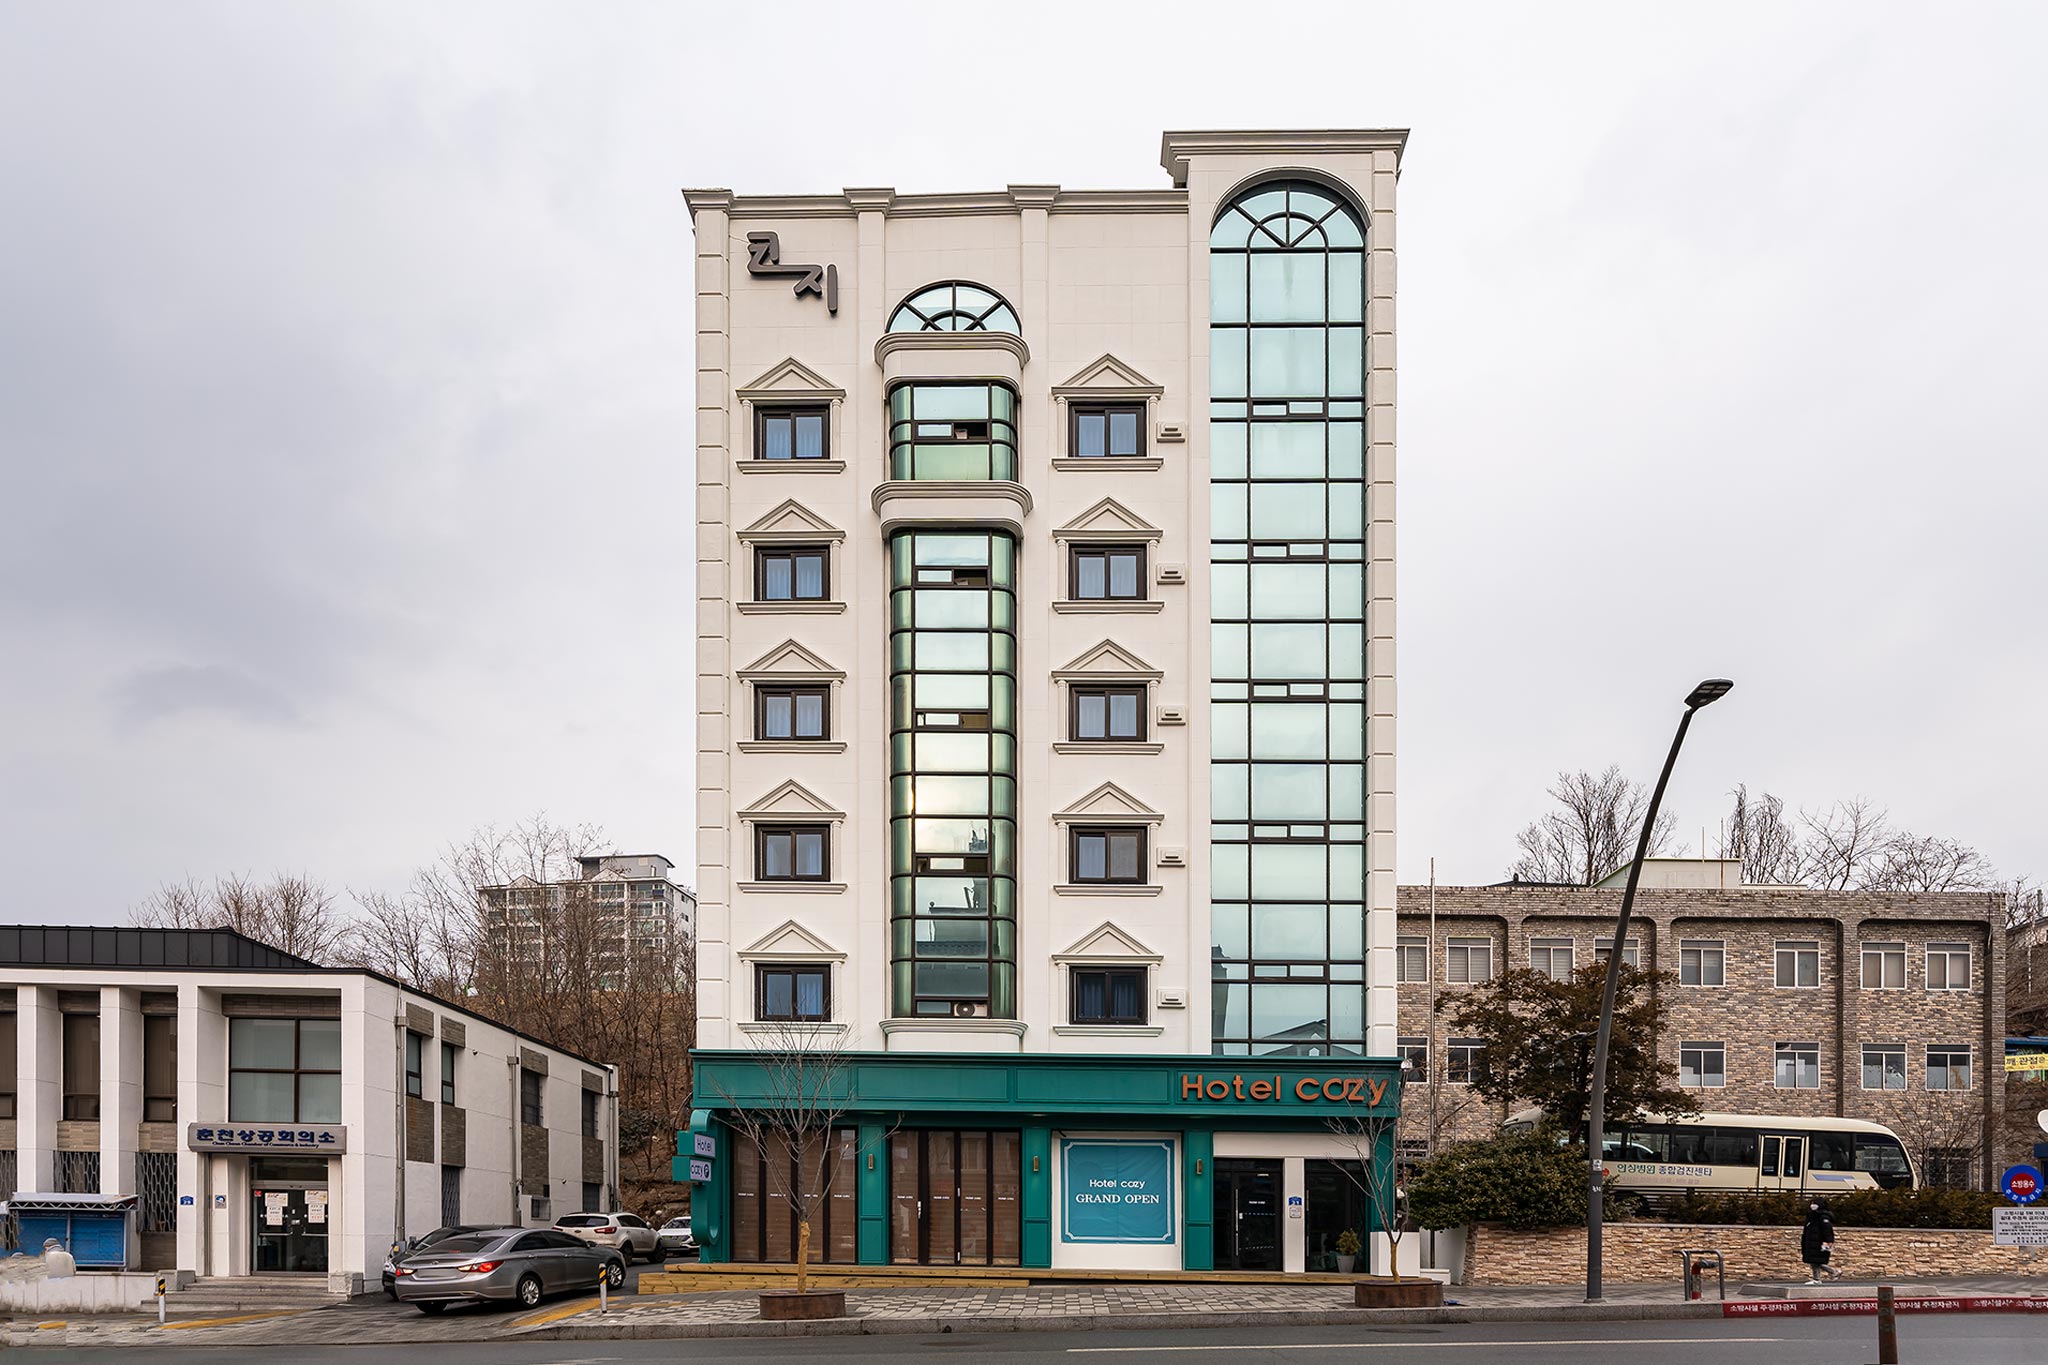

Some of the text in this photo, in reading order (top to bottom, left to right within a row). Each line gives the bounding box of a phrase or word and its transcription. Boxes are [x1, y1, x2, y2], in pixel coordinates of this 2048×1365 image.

[1181, 1074, 1389, 1106] Hotel cozy
[196, 1128, 335, 1143] 춘천상공회의소
[1089, 1179, 1146, 1189] Hotel cozy
[1075, 1193, 1160, 1204] GRAND OPEN
